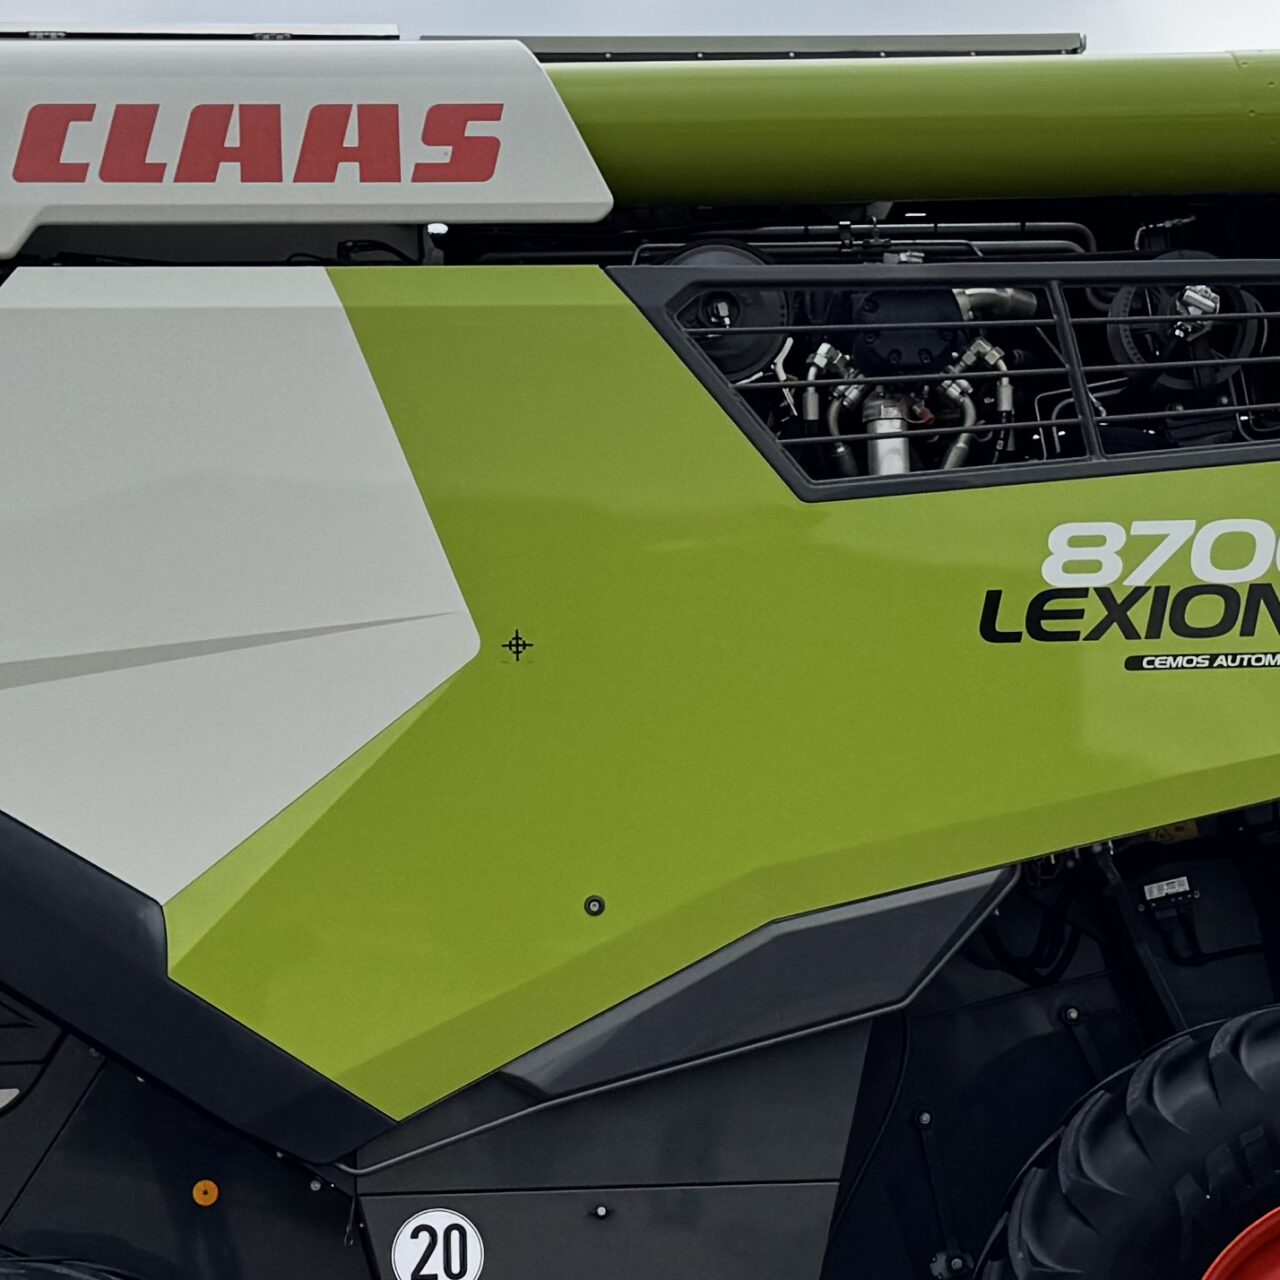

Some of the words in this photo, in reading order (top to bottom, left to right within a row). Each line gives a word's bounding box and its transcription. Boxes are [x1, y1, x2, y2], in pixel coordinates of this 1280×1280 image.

[12, 103, 504, 183] CLAAS
[1141, 654, 1210, 670] CEMOS
[410, 1223, 468, 1280] 20
